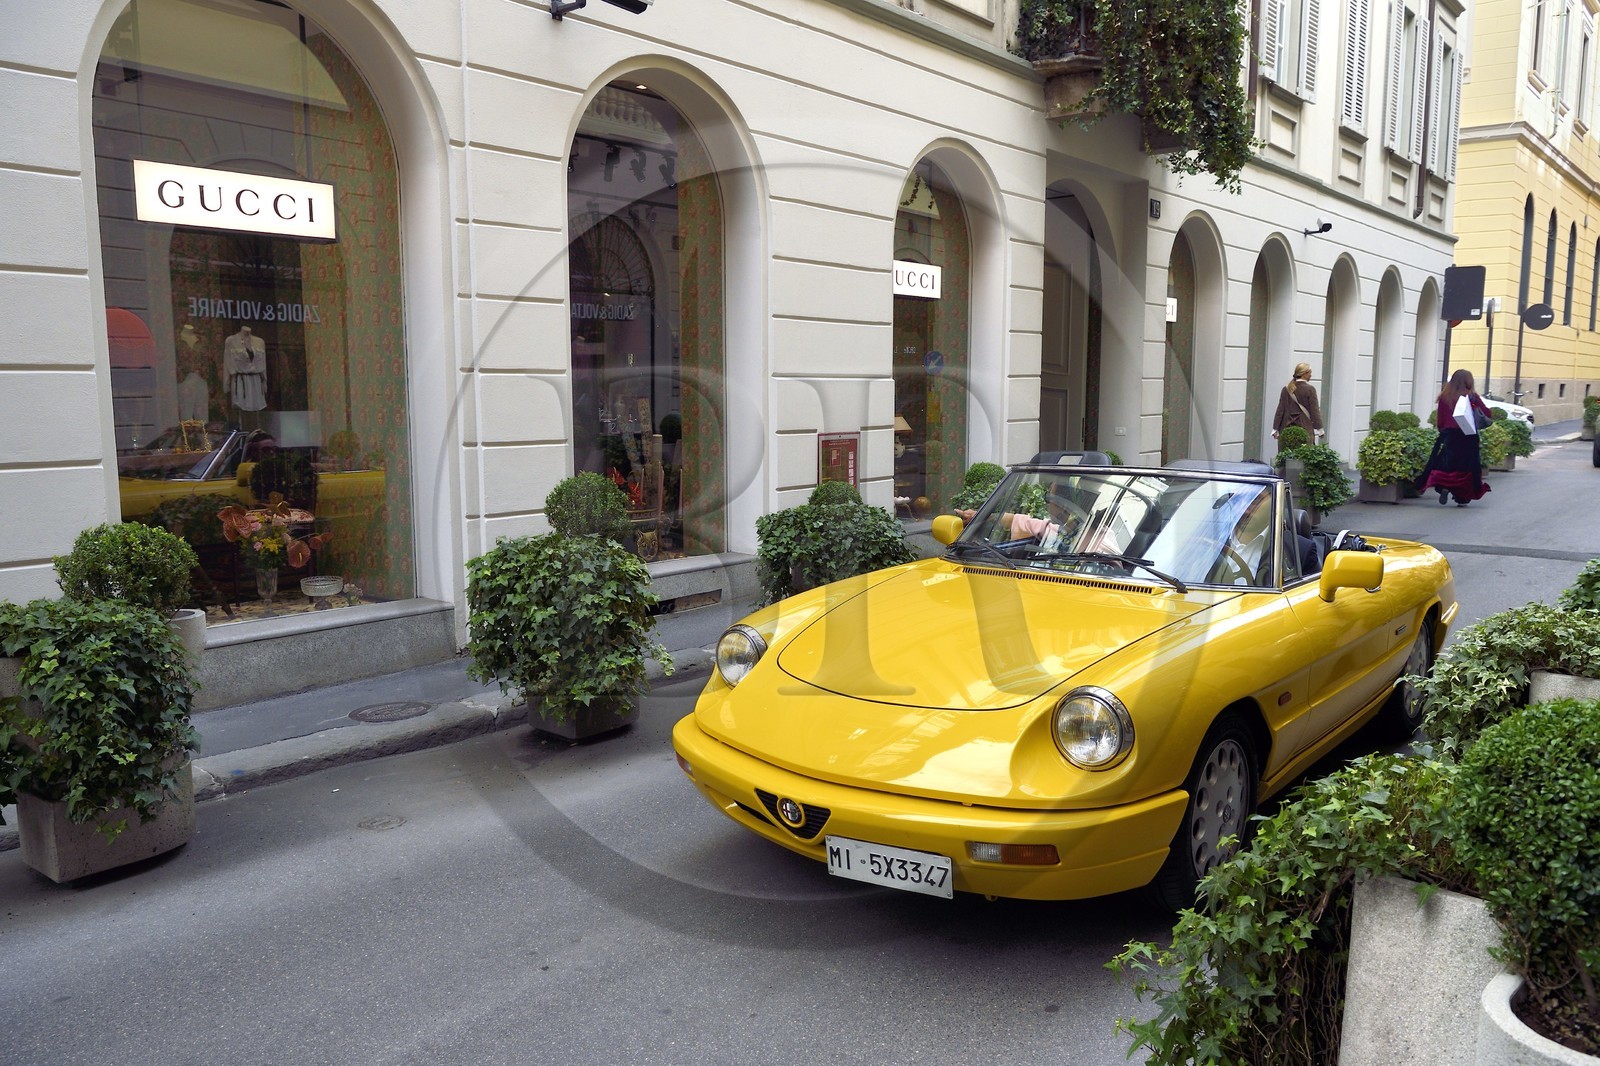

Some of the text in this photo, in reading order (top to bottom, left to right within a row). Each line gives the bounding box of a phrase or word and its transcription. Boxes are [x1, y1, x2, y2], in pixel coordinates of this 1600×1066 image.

[157, 179, 315, 223] GUCCI
[829, 845, 949, 888] MI 5X3347
